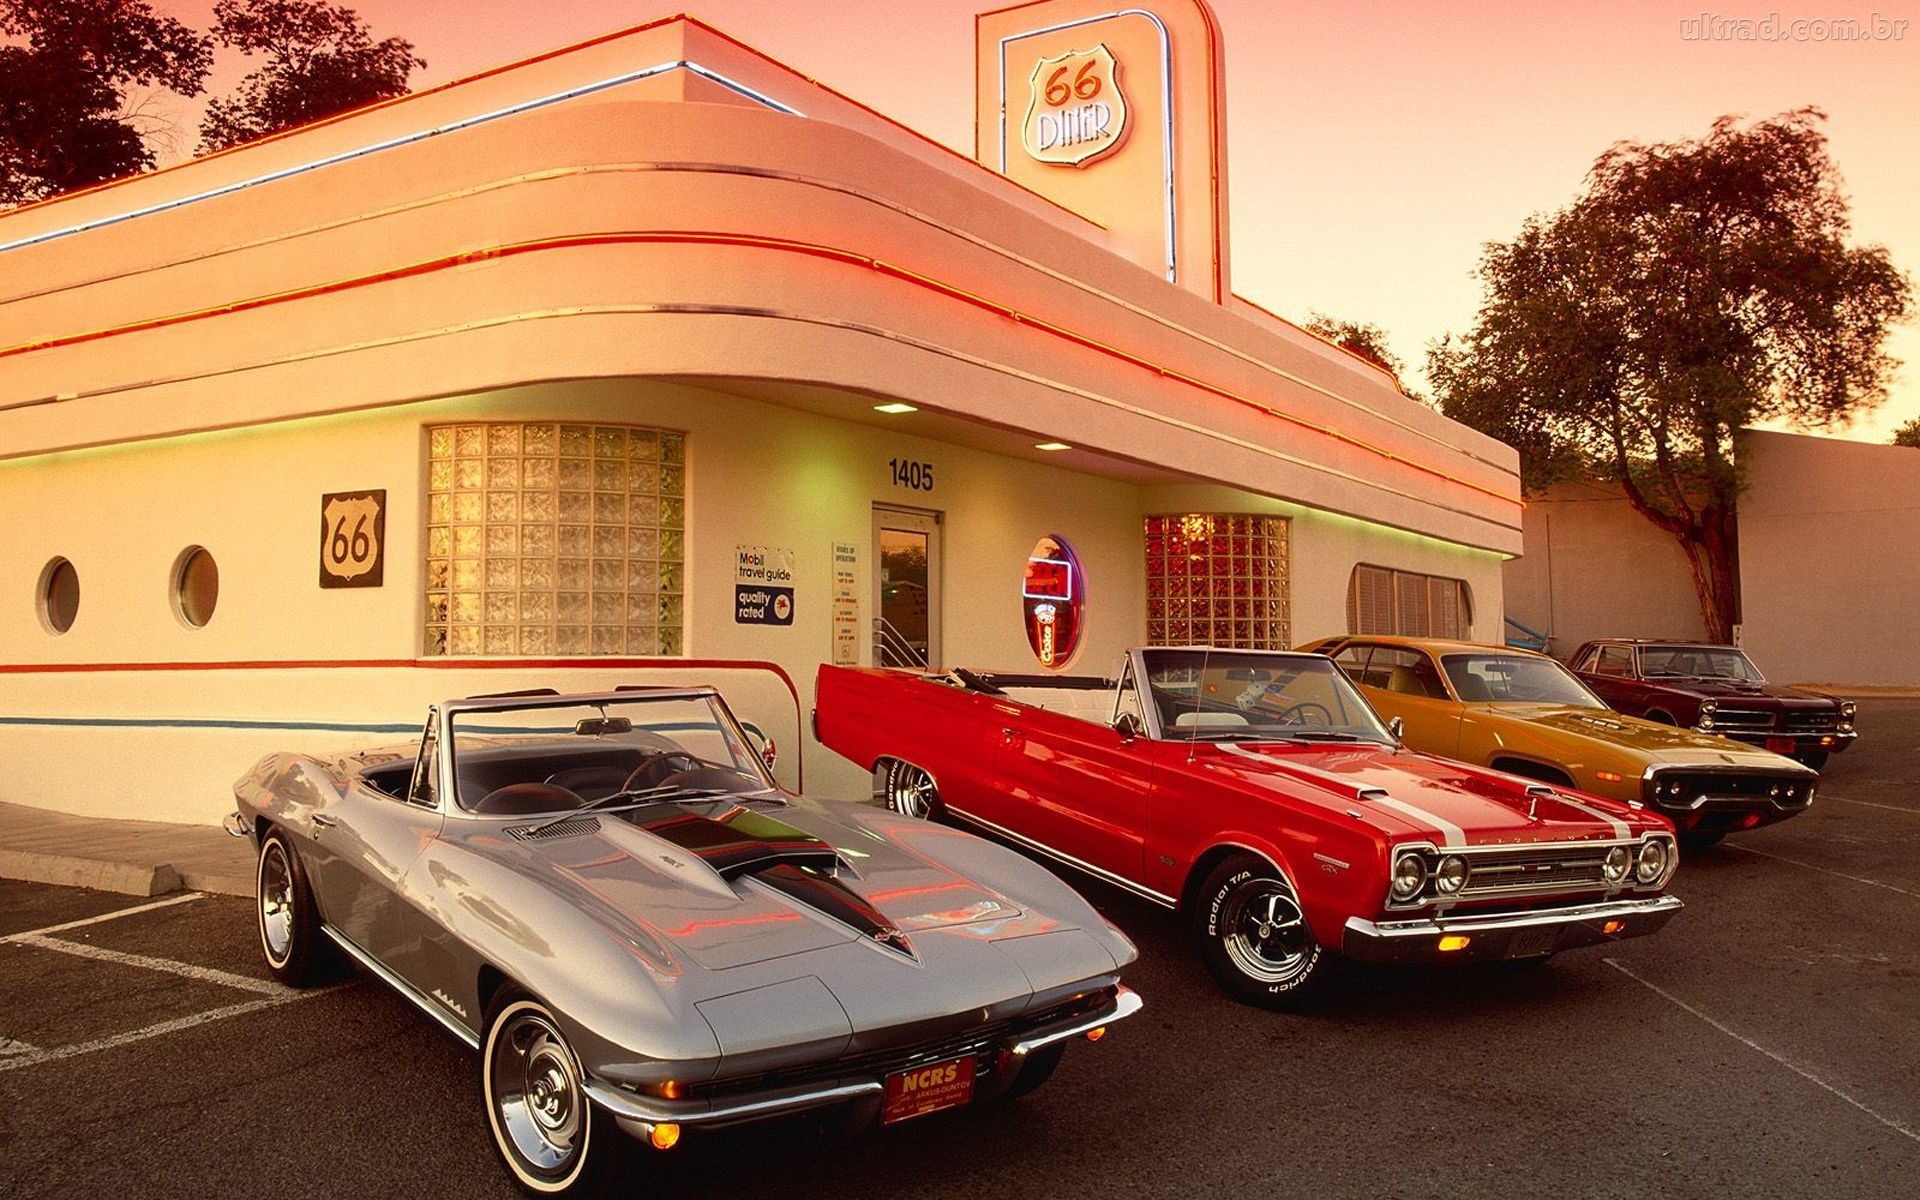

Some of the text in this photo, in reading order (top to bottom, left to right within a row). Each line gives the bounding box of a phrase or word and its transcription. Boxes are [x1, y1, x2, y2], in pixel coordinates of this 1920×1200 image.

[1044, 59, 1102, 107] 66
[1038, 103, 1111, 151] DINER
[889, 458, 934, 491] 1405
[332, 513, 370, 564] 66
[739, 566, 791, 581] travel guide
[740, 552, 765, 565] Mobil
[739, 591, 771, 607] quality
[739, 606, 765, 618] rated
[888, 759, 900, 810] Goodric
[1208, 870, 1251, 936] Radial T/A
[903, 1064, 958, 1093] NCRS
